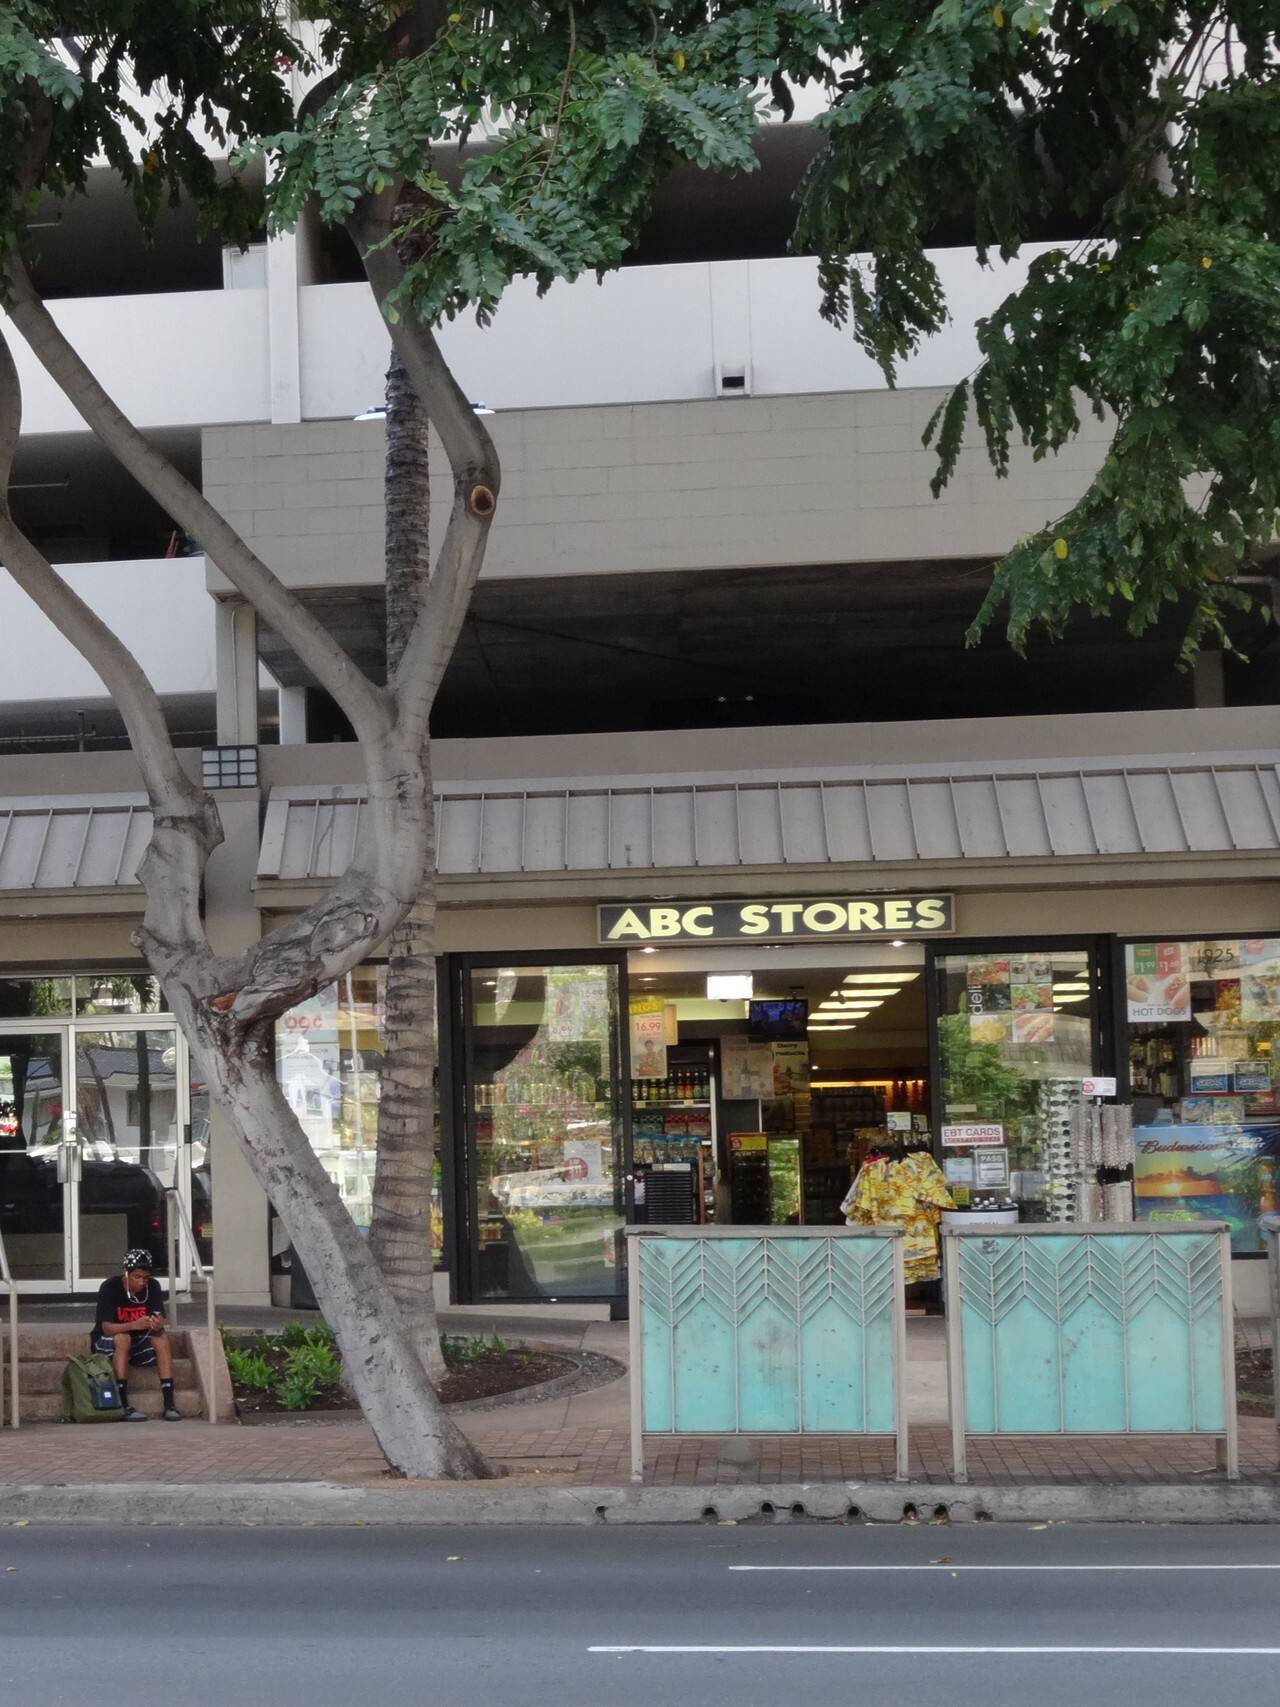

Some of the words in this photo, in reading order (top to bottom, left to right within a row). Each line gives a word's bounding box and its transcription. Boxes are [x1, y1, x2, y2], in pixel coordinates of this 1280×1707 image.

[607, 907, 714, 939] ABC
[739, 899, 946, 934] STORES
[969, 984, 984, 1015] deli
[1132, 1007, 1154, 1017] HOT
[1157, 1007, 1187, 1016] DOGS
[636, 1022, 661, 1033] 16.99
[943, 1128, 962, 1138] EBT
[965, 1127, 1001, 1137] CARDS
[1137, 1139, 1219, 1154] Budweiser
